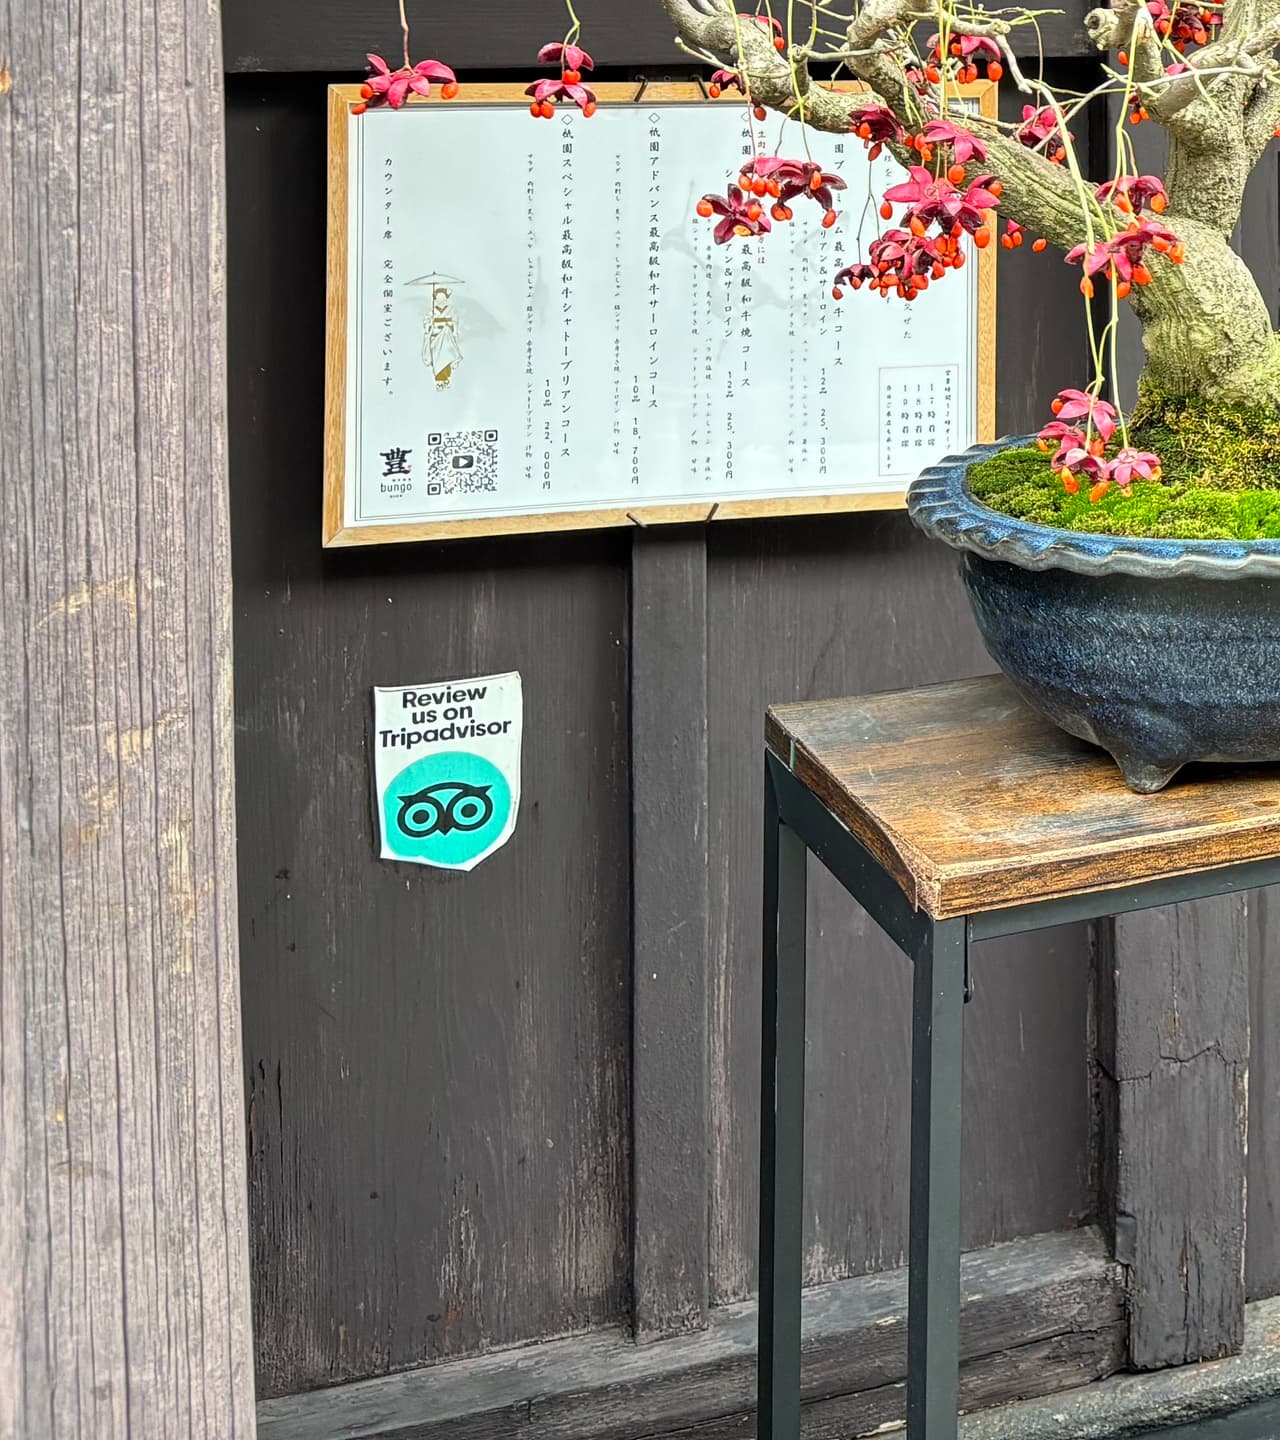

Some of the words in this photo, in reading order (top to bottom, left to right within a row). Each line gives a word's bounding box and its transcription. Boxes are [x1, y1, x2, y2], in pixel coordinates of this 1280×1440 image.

[379, 483, 414, 494] bungo
[402, 686, 488, 708] Review
[412, 710, 437, 724] us
[443, 705, 473, 721] on
[379, 719, 512, 749] Tripadvisor
